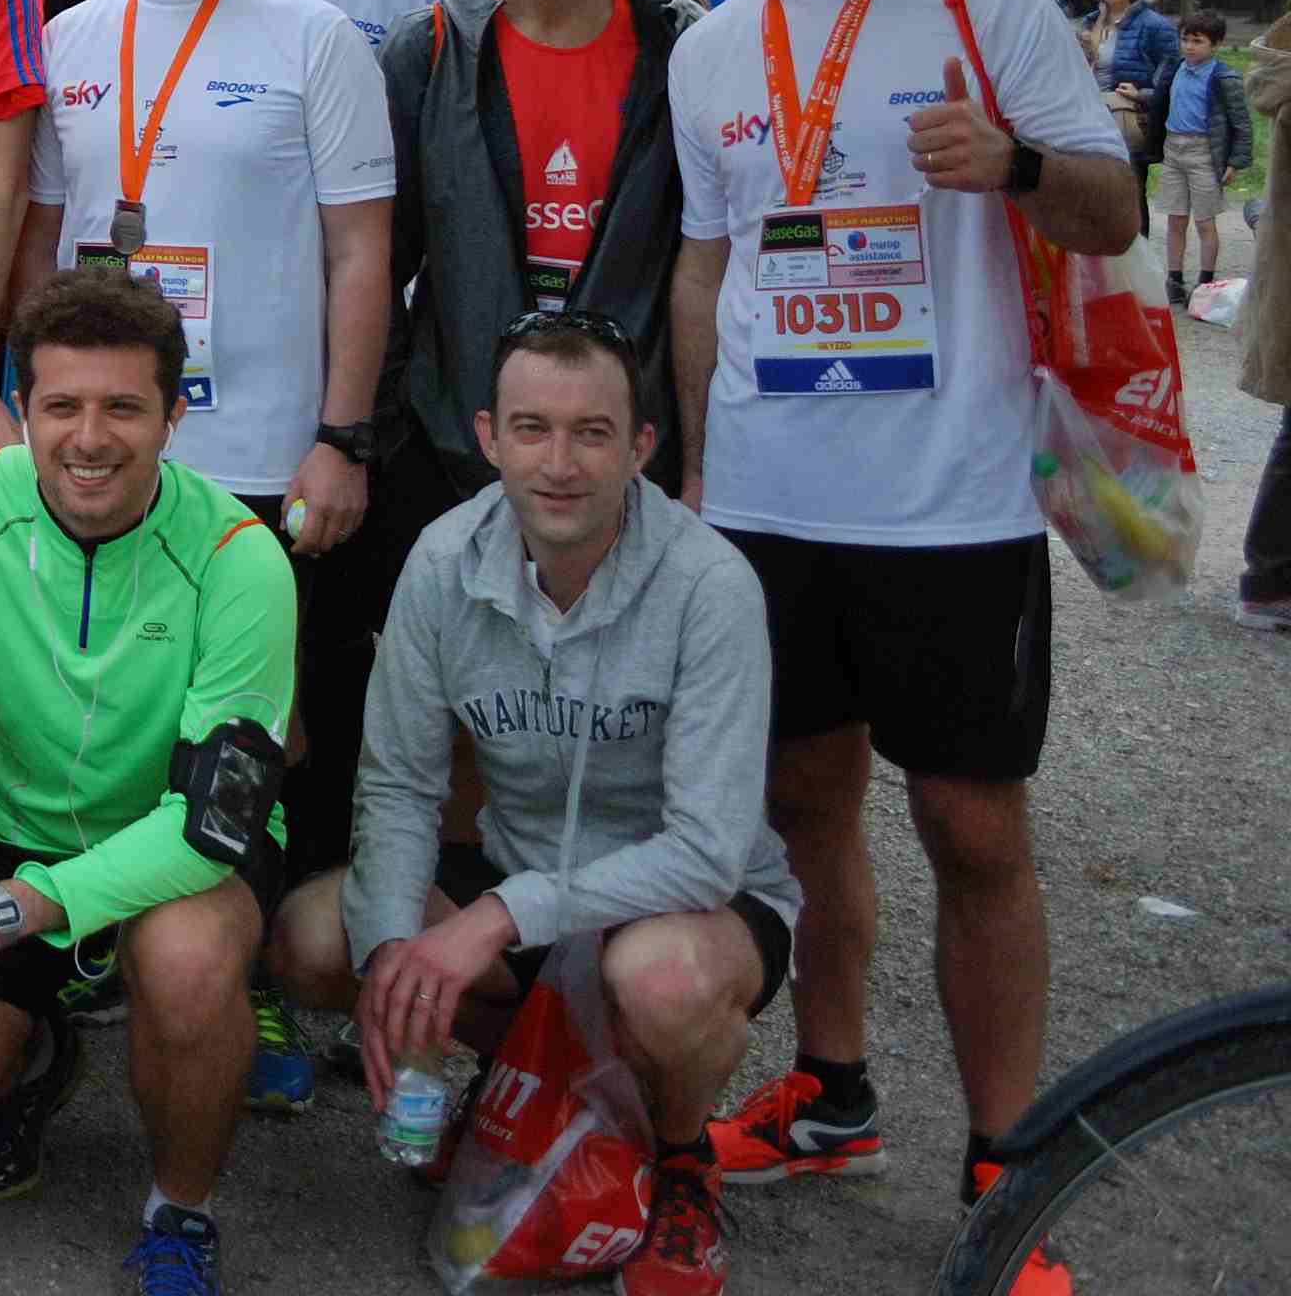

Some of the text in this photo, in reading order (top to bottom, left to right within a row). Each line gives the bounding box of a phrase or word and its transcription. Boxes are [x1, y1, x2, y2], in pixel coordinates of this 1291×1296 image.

[63, 80, 112, 110] sky
[206, 80, 268, 94] BROOKS
[889, 90, 947, 105] BROOK
[772, 291, 903, 336] 1031D
[814, 378, 863, 393] adidas
[462, 688, 663, 743] NANTUCKET
